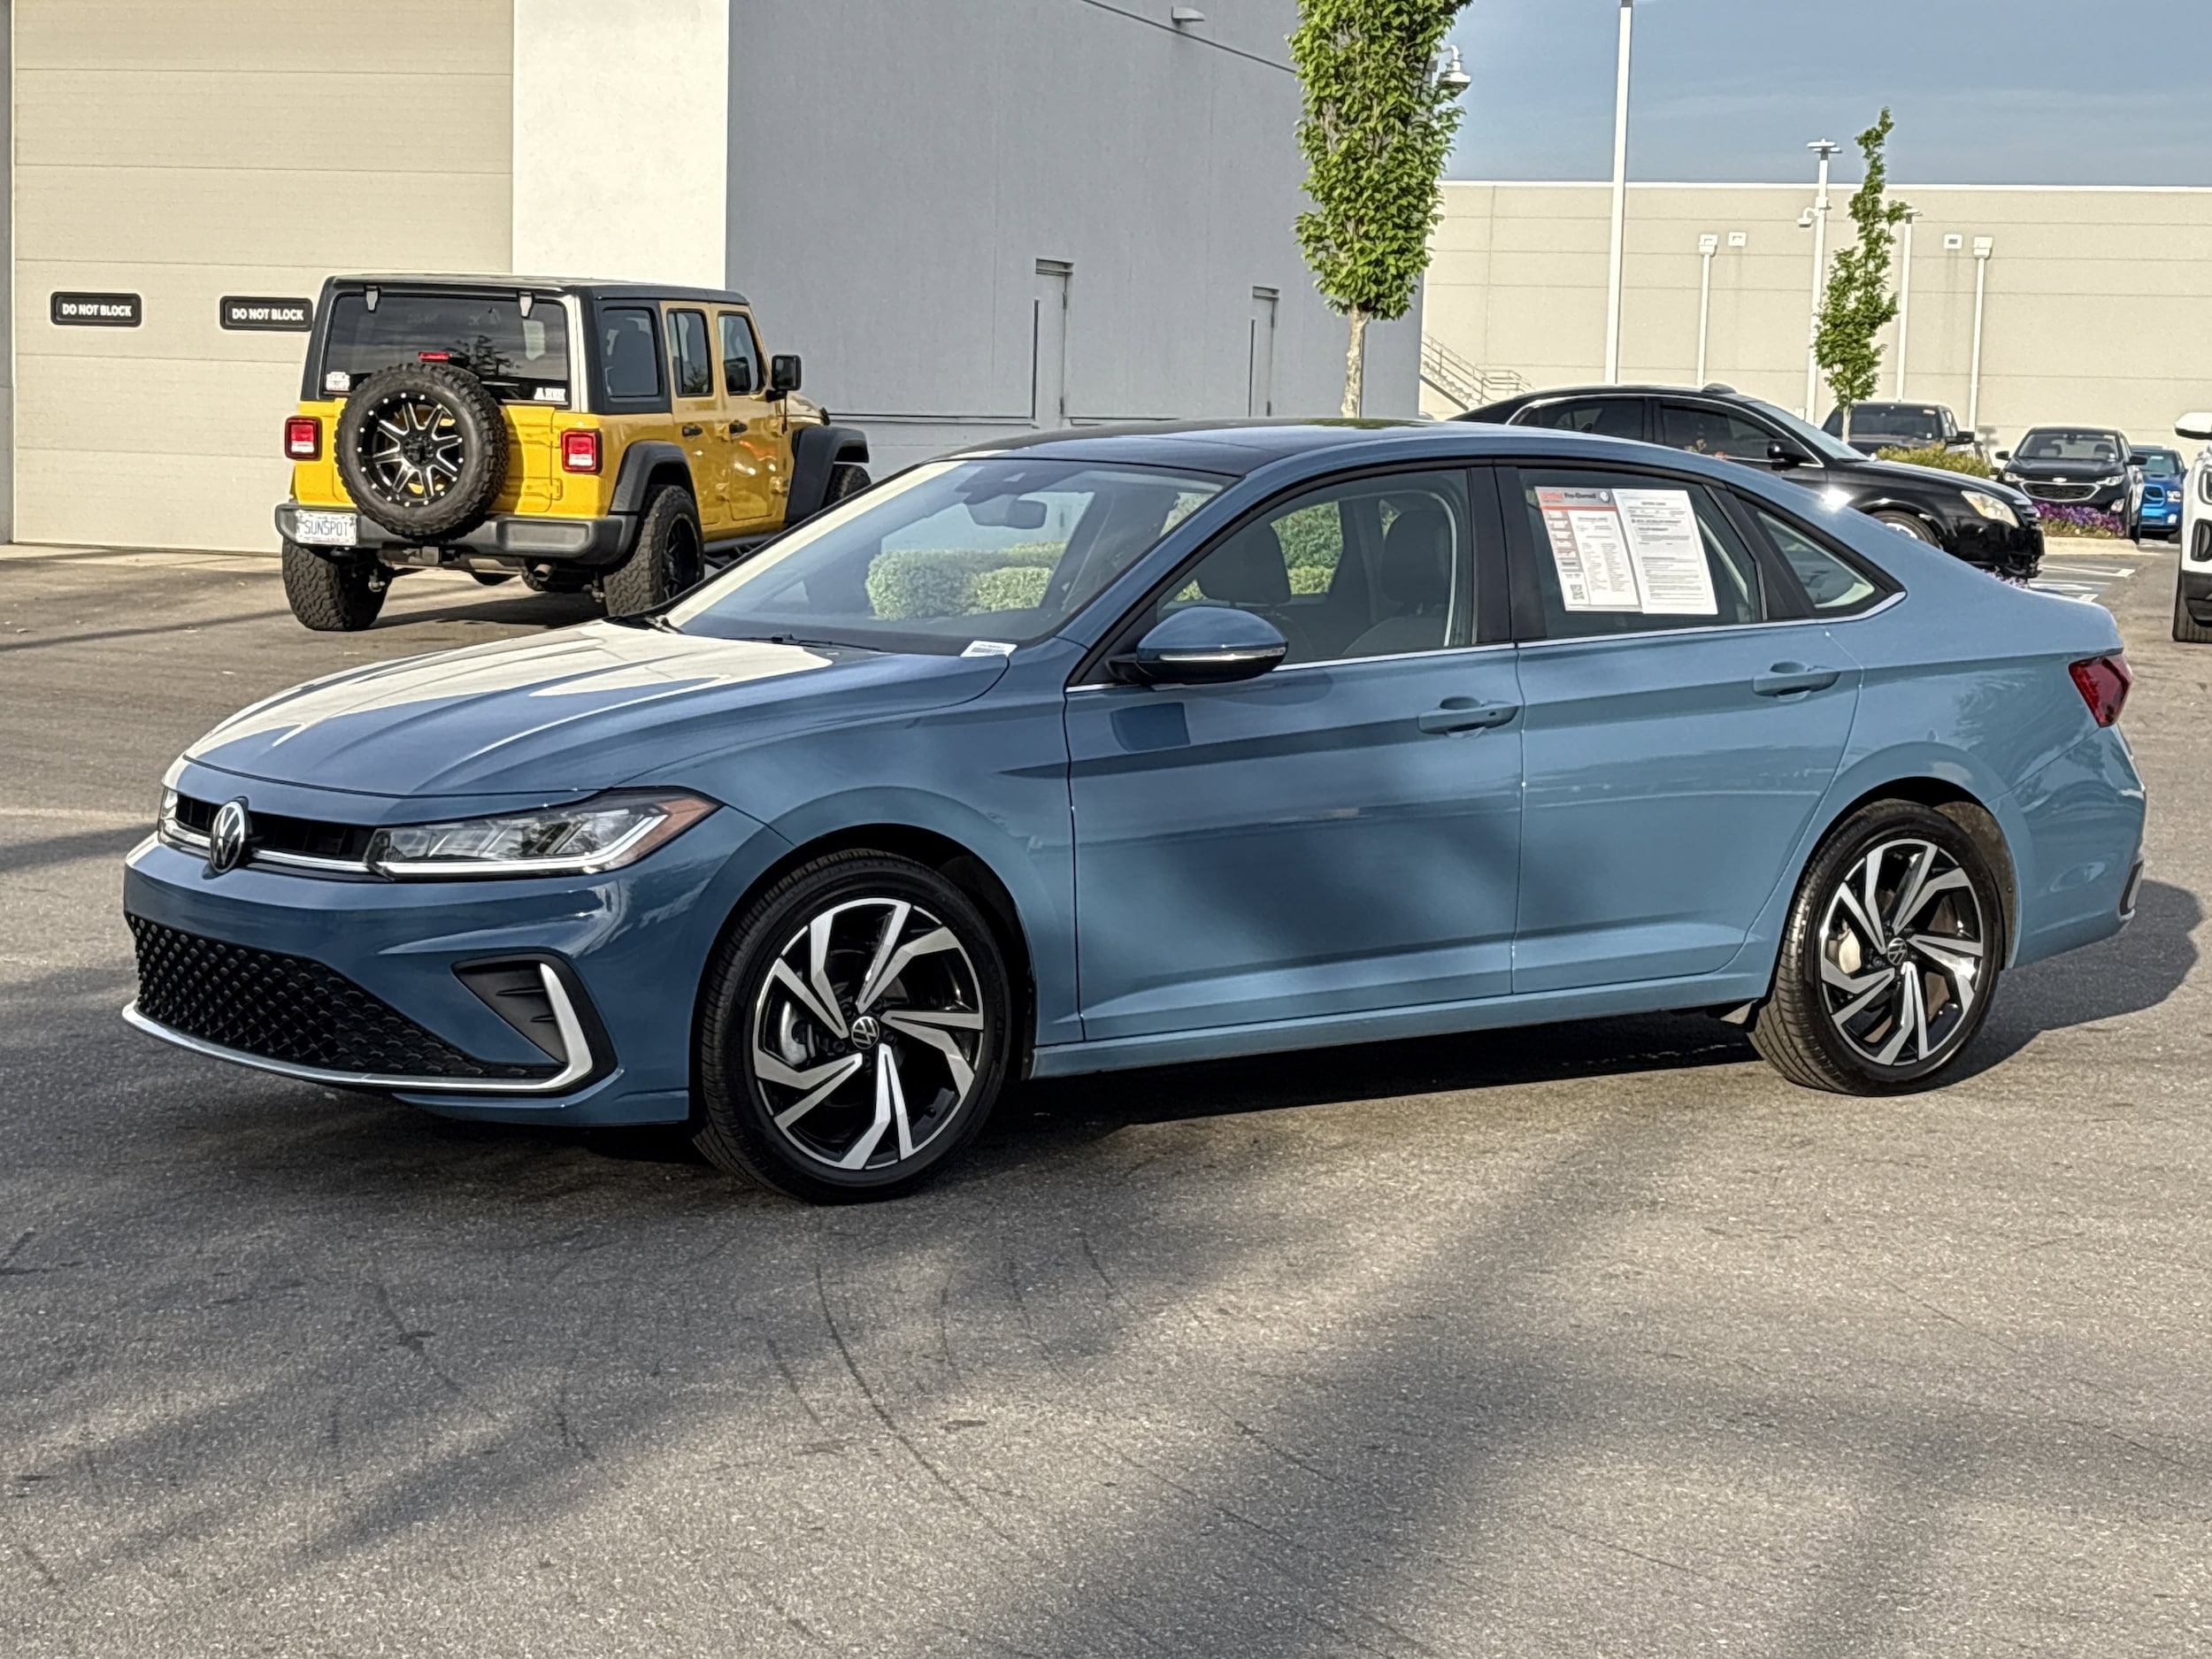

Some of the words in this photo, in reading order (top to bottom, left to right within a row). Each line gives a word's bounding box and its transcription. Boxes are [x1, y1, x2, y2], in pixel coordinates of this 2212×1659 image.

[62, 303, 77, 315] DO
[78, 303, 99, 316] NOT
[100, 304, 132, 317] BLOCK
[232, 308, 247, 319] DO
[249, 308, 270, 320] NOT
[271, 309, 304, 321] BLOCK
[303, 519, 349, 537] SUNSPOT
